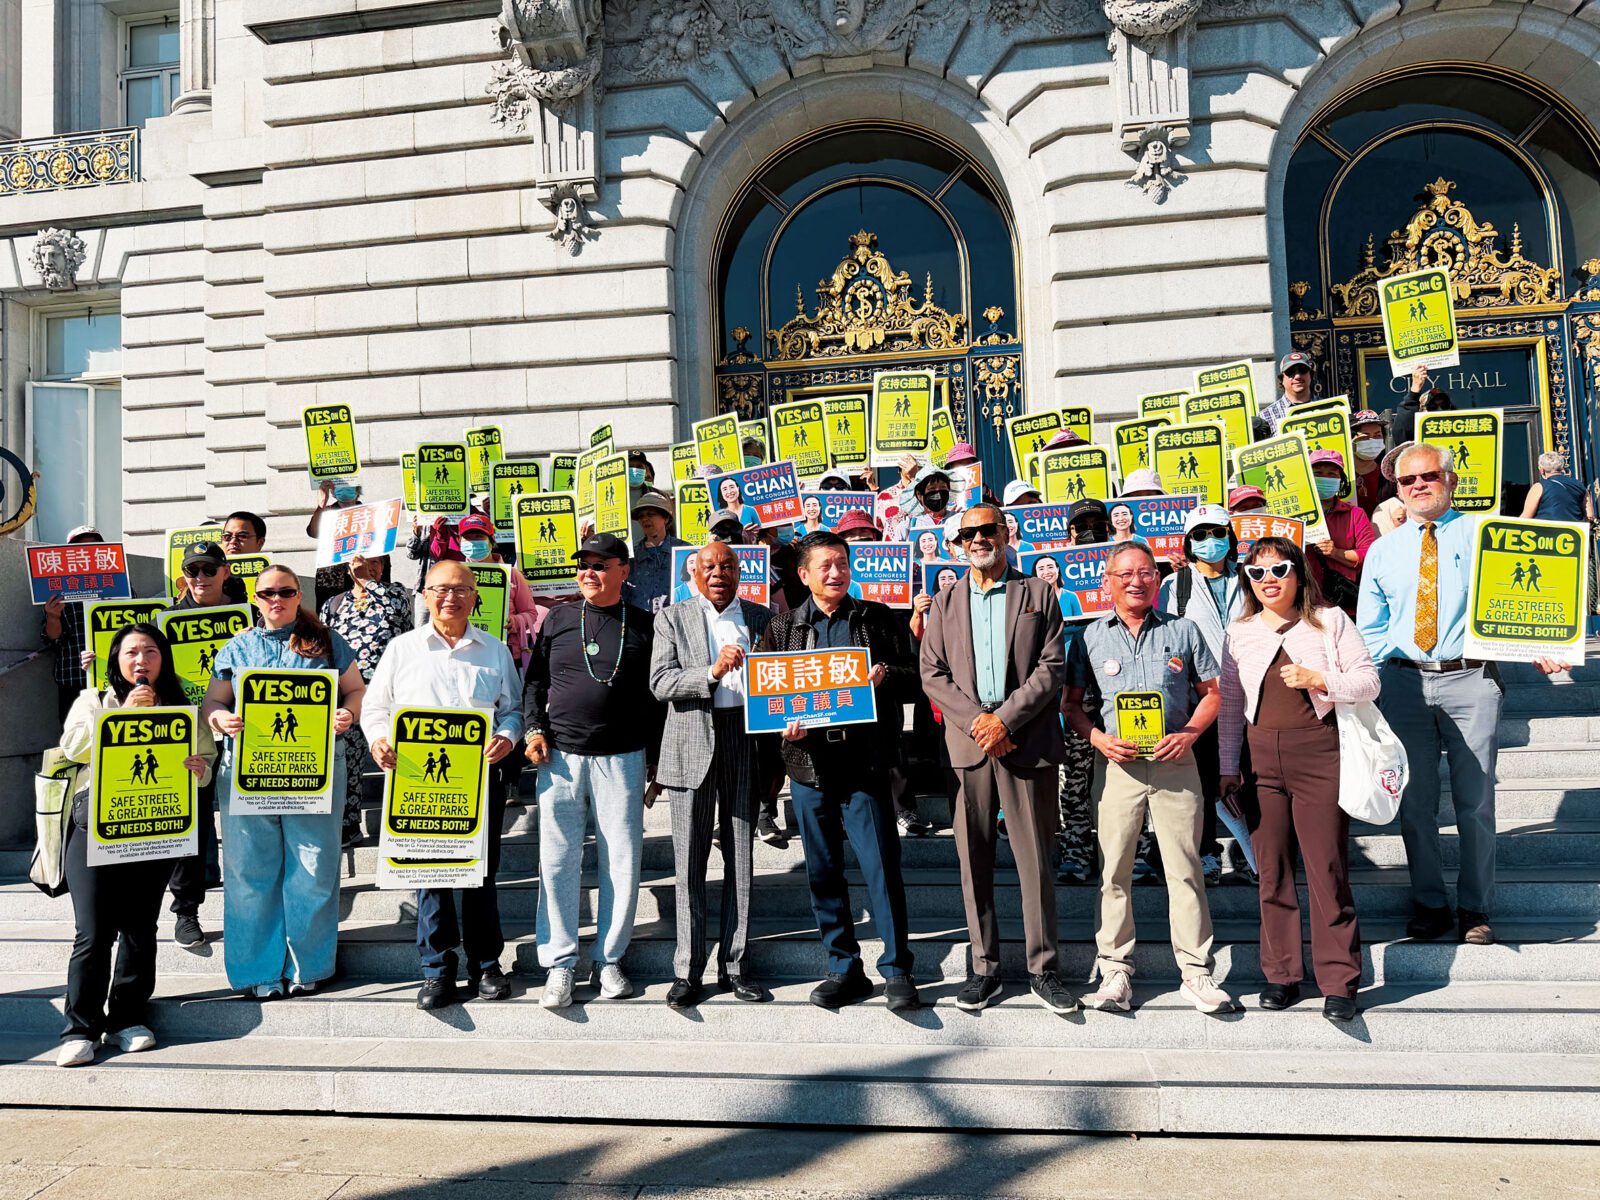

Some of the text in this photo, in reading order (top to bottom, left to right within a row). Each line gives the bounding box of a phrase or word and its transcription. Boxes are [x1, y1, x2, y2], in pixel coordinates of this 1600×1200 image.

[1387, 275, 1443, 300] YES ON G
[1398, 324, 1445, 340] SAFE STREETS
[1404, 332, 1447, 345] GREAT PARKS
[1398, 341, 1449, 358] SF NEEDS BOTH!
[881, 377, 927, 390] 支持G提案
[1389, 371, 1507, 393] CIY HALL
[306, 409, 349, 425] YES ON G
[777, 406, 820, 425] YES ON G
[938, 414, 947, 427] G
[1070, 414, 1079, 422] ON
[1079, 411, 1088, 424] G
[699, 420, 735, 440] YES G
[756, 425, 764, 436] G
[1318, 422, 1328, 433] ON
[1328, 416, 1341, 433] G
[1425, 418, 1493, 434] 支持G提案
[468, 431, 500, 446] YES G
[1119, 425, 1147, 443] YES
[1157, 429, 1217, 448] 支持G提案
[315, 450, 350, 460] SAFE STREETS
[421, 448, 463, 462] YES G
[799, 450, 820, 458] STREETS
[805, 457, 823, 465] PARKS
[1047, 452, 1103, 470] 支持G提案
[1241, 440, 1300, 467] 支持G提案
[495, 465, 536, 477] 支持G提案
[742, 465, 791, 482] CONNIE
[744, 475, 793, 496] CHAN
[682, 487, 708, 502] YES
[752, 494, 765, 502] FOR
[765, 489, 795, 499] CONGRESS
[826, 495, 872, 505] CONNIE
[520, 498, 571, 513] 支持G提案
[1022, 507, 1067, 519] CONNI
[1138, 499, 1195, 512] CONNIE
[1231, 518, 1297, 539] 詩敏
[1487, 527, 1575, 554] YES ON G
[855, 547, 908, 557] CONNIE
[1064, 548, 1110, 564] CONN
[36, 548, 119, 575] 陳詩敏
[230, 560, 265, 575] G提案
[739, 560, 764, 574] AN
[853, 557, 907, 572] CHAN
[473, 570, 502, 585] G提案
[1065, 560, 1106, 580] CHA
[48, 574, 115, 591] 國會議員
[1085, 590, 1112, 604] 陳詩
[1489, 598, 1564, 612] SAFE STREETS
[96, 609, 136, 629] YES
[136, 613, 149, 624] ON
[1485, 610, 1566, 624] & GREAT PARKS
[170, 616, 242, 641] YES ON G
[1481, 623, 1568, 638] SF NEEDS BOTH!
[756, 653, 861, 693] 陳詩敏
[185, 685, 206, 697] SAFE
[249, 679, 326, 703] YES ON G
[768, 690, 854, 715] 國會議員
[1118, 697, 1143, 709] YES
[1149, 697, 1159, 709] G
[107, 718, 186, 743] YES ON G
[402, 717, 480, 743] YES ON G
[252, 751, 316, 762] SAFE STREETS
[248, 763, 318, 774] & GREAT PARKS
[246, 777, 319, 788] SF NEEDS BOTH!
[111, 792, 179, 808] SAFE STREETS
[402, 792, 468, 804] SAFE STREETS
[108, 804, 181, 820] & GREAT PARKS
[399, 804, 469, 816] & GREAT PARKS
[106, 819, 183, 836] SF NEEDS BOTH!
[396, 819, 470, 831] SF NEEDS BOTH!
